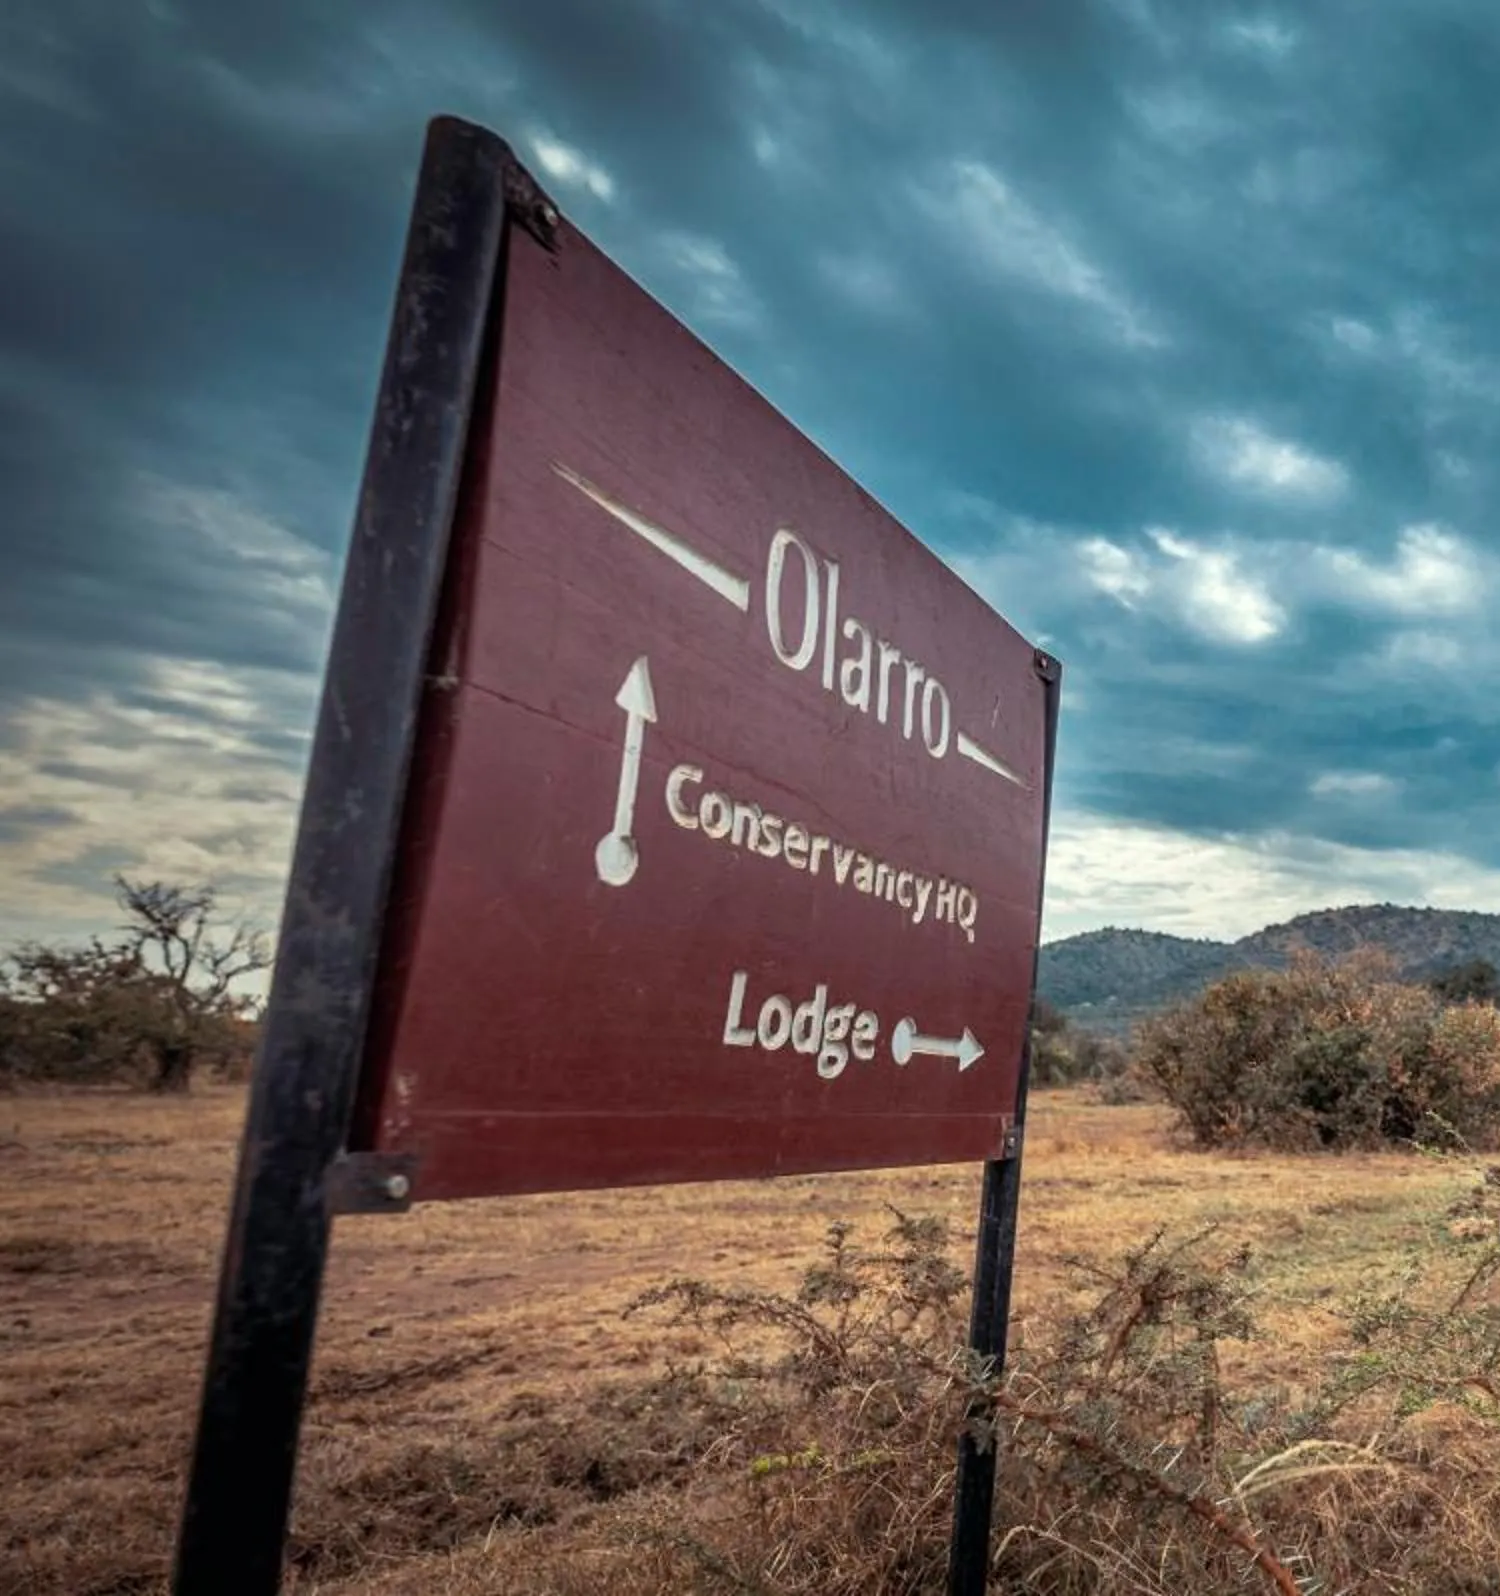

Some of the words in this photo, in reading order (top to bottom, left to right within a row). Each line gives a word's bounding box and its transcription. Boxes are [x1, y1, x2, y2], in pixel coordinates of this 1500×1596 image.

[764, 528, 952, 760] Olarro
[664, 764, 934, 925] Conservancy
[935, 878, 979, 944] HQ
[722, 973, 879, 1080] Lodge
